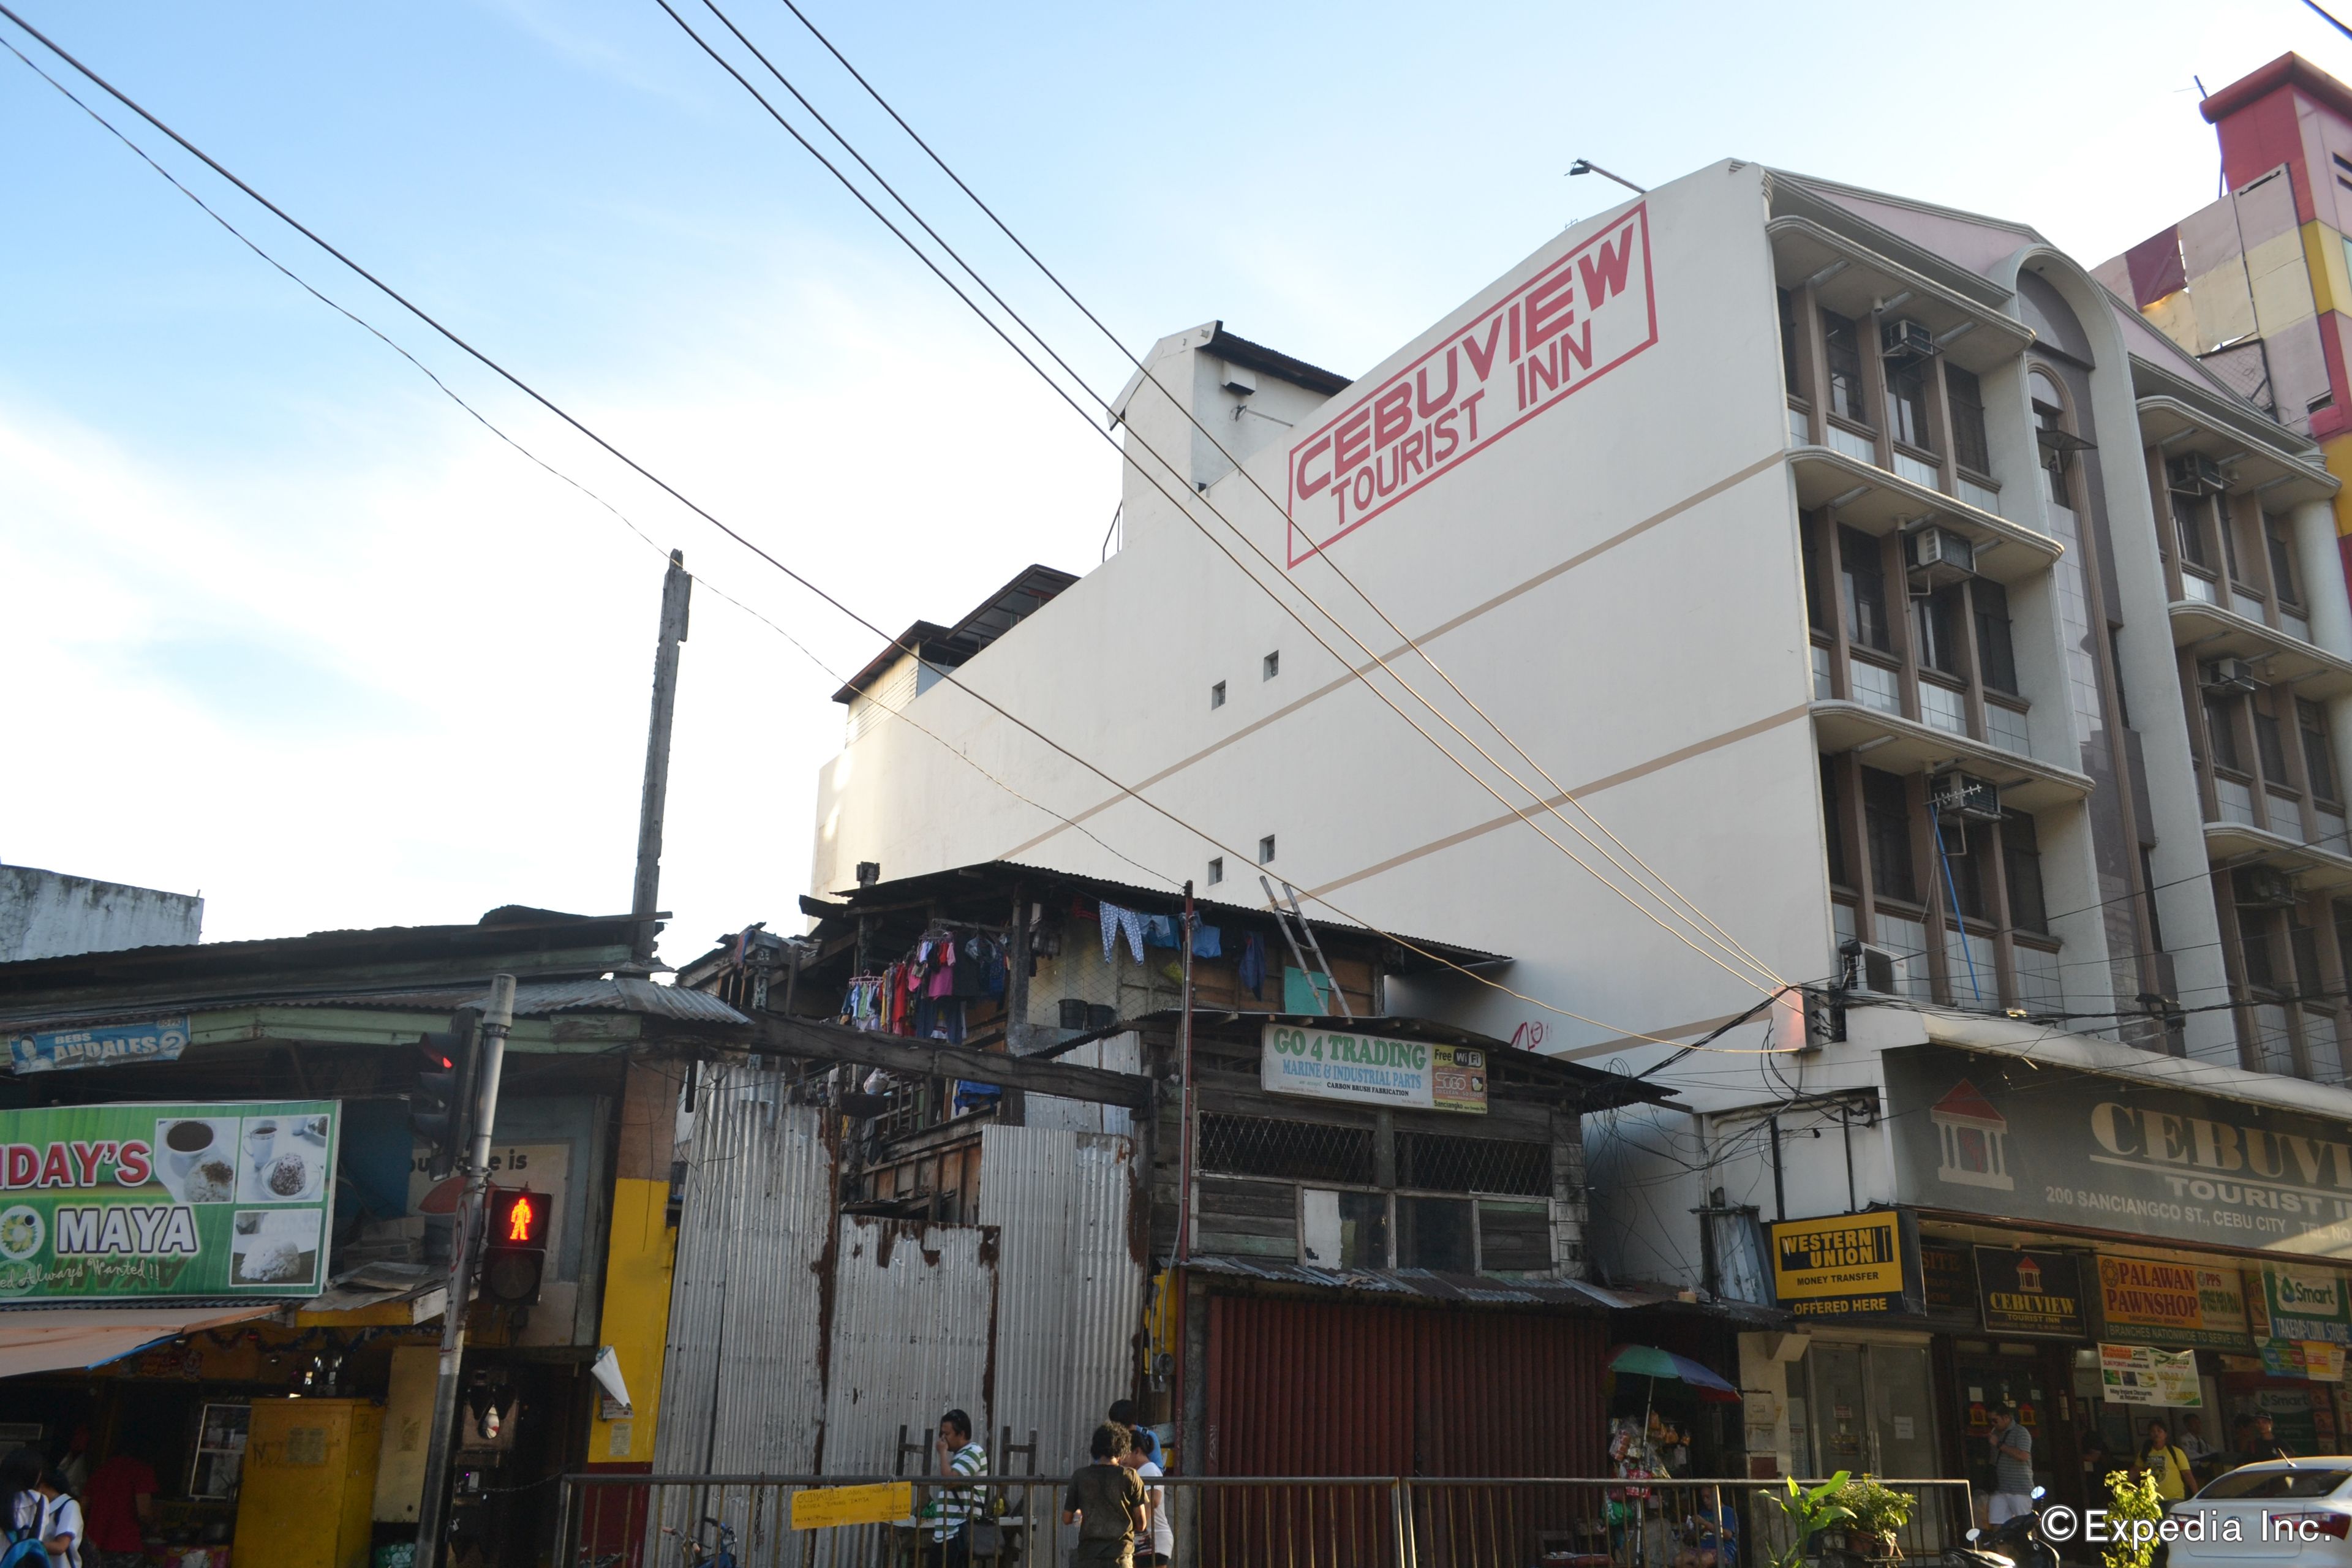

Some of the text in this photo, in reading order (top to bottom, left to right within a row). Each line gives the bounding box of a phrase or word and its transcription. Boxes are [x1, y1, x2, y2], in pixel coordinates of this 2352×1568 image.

[1297, 222, 1634, 500] CEBUVIEW
[1330, 318, 1593, 526] TOURIST INN
[54, 1036, 181, 1061] ANDALES 2
[55, 1033, 92, 1044] BEBS
[1273, 1028, 1426, 1070] GO 4 TRADING
[1434, 1049, 1452, 1061] Free
[1283, 1059, 1421, 1089] MARINE & INDUSTRIAL PARTS
[1327, 1082, 1351, 1090] CARBON
[1352, 1084, 1371, 1093] BRUSH
[1372, 1087, 1409, 1096] FABRICATION
[1434, 1100, 1463, 1110] Sanciangko
[508, 1148, 527, 1170] is
[2165, 1176, 2322, 1215] TOURIST
[2046, 1186, 2073, 1205] 200
[2078, 1190, 2180, 1221] SANCIANGCO
[2213, 1211, 2252, 1231] CEBU
[2256, 1216, 2286, 1234] CITY
[58, 1207, 197, 1253] MAYA
[1781, 1229, 1872, 1254] WESTERN
[1810, 1246, 1873, 1268] UNION
[17, 1264, 83, 1286] Always
[1797, 1272, 1879, 1286] MONEY TRANSFER
[2118, 1262, 2221, 1291] PALAWAN PPS
[1991, 1292, 2075, 1314] CEBUVIEW
[2106, 1289, 2198, 1317] PAWNSHOP
[2295, 1281, 2334, 1305] Smart
[1794, 1298, 1887, 1315] OFFERED HERE
[2109, 1325, 2247, 1346] BRANCHES NATIONWIDE TO SERVE YOU
[2271, 1393, 2310, 1406] Smart
